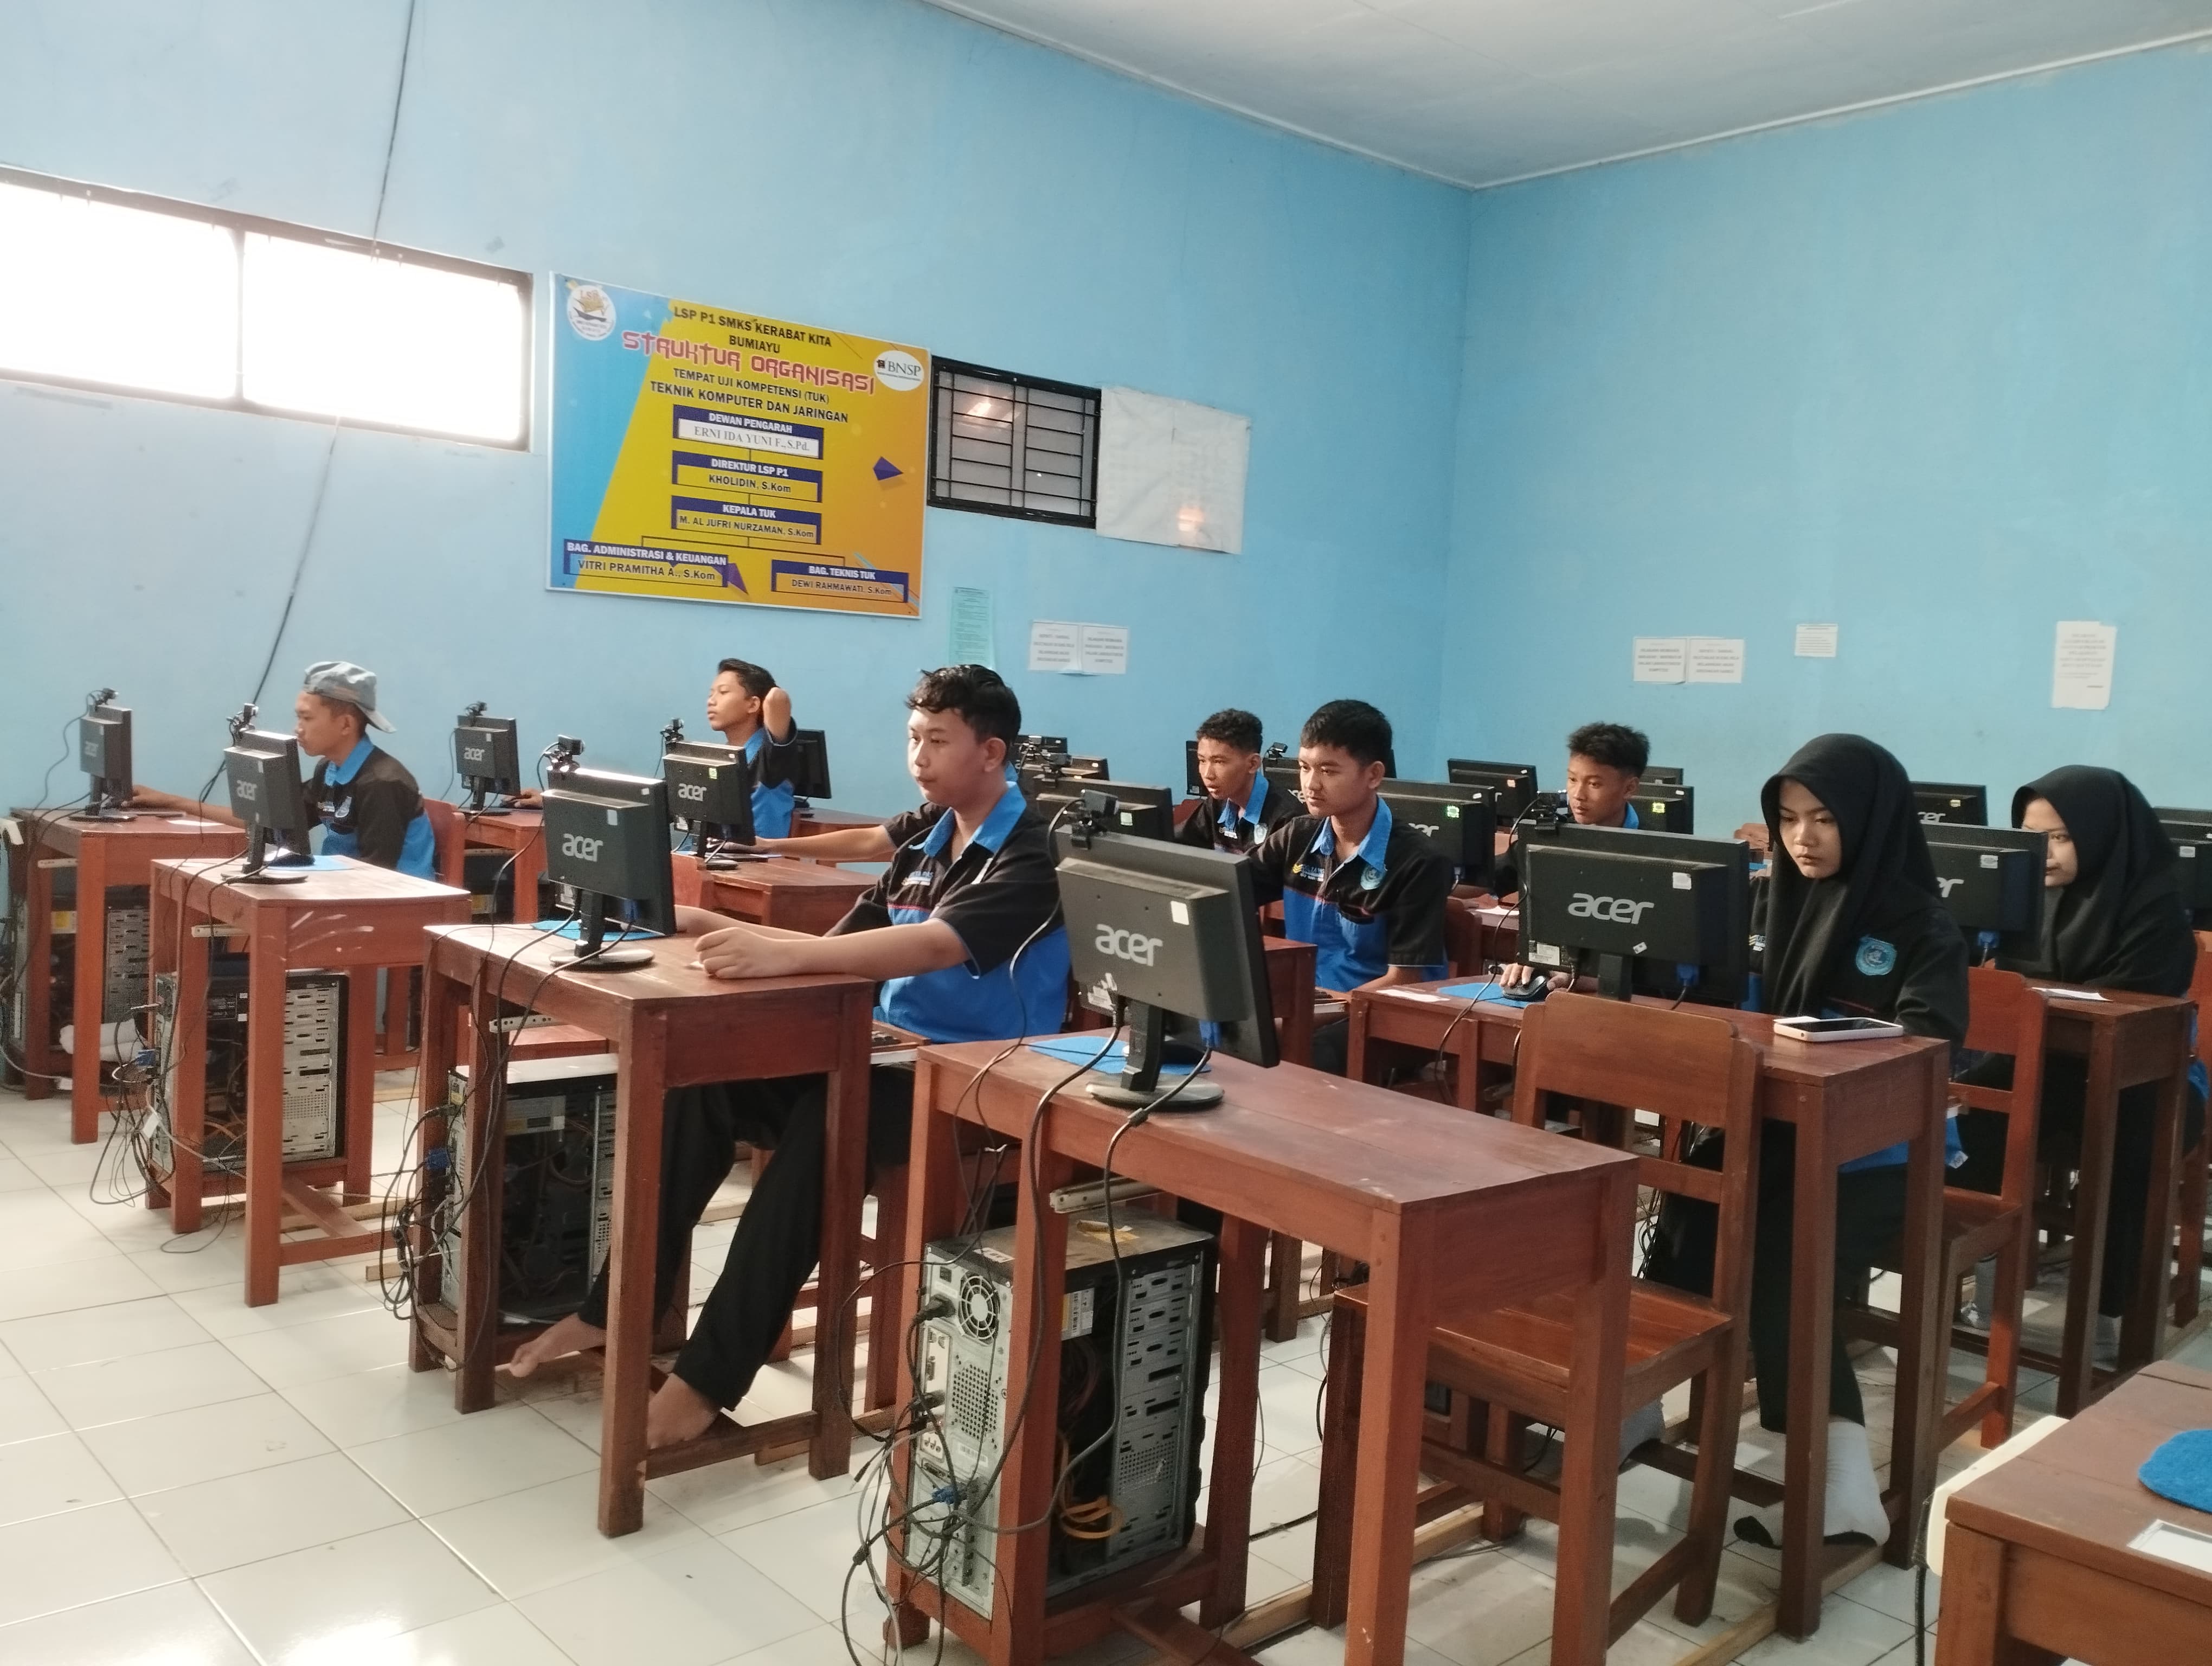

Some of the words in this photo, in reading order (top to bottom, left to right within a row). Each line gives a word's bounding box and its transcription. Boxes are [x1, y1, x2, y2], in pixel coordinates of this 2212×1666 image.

[674, 306, 697, 319] LSP
[700, 312, 715, 324] P1
[719, 316, 751, 331] SMKS
[755, 323, 806, 341] KERABAT
[808, 334, 832, 347] KITA
[729, 335, 780, 353] BUMIAYU
[623, 331, 741, 372] STRUKTUR
[751, 356, 874, 395] ORGANISASI
[888, 361, 921, 376] BNSP
[673, 368, 715, 383] TEMPAT
[718, 376, 733, 387] UJI
[737, 379, 801, 399] KOMPETENSI
[805, 391, 829, 405] (TUK)
[651, 381, 694, 398] TEKNIK
[699, 389, 763, 409] KOMPUTER
[767, 400, 790, 413] DAN
[793, 405, 848, 422] JARINGAN
[709, 413, 742, 426] DEWAN
[744, 418, 792, 433] PENGARAH
[695, 426, 721, 439] ERNI
[724, 431, 743, 443] IDA
[744, 434, 771, 446] YUNI
[711, 458, 757, 473] DIREKTUR
[758, 465, 775, 475] LSP
[776, 467, 789, 477] P1
[762, 481, 791, 493] S.Kom
[723, 504, 757, 516] KEPALA
[758, 509, 776, 518] TUK
[679, 516, 689, 524] M.
[693, 517, 704, 526] AL
[706, 519, 731, 529] JUFRI
[788, 528, 814, 538] S.Kom
[567, 542, 591, 553] BAG.
[594, 545, 664, 560] ADMINISTRASI
[666, 552, 674, 561] &
[676, 553, 726, 565] KEUANGAN
[578, 560, 606, 571] VITRI
[610, 563, 664, 576] PRAMITHA
[684, 569, 715, 580] S.Kom
[808, 566, 828, 575] BAG.
[829, 568, 859, 578] TEKNIS
[860, 571, 876, 579] TUK
[792, 579, 813, 588] DEWI
[85, 741, 99, 756] acer
[464, 747, 485, 761] acer
[236, 779, 257, 801] acer
[678, 783, 706, 802] acer
[562, 833, 602, 862] acer
[1568, 892, 1654, 925] acer
[1095, 924, 1163, 966] acer
